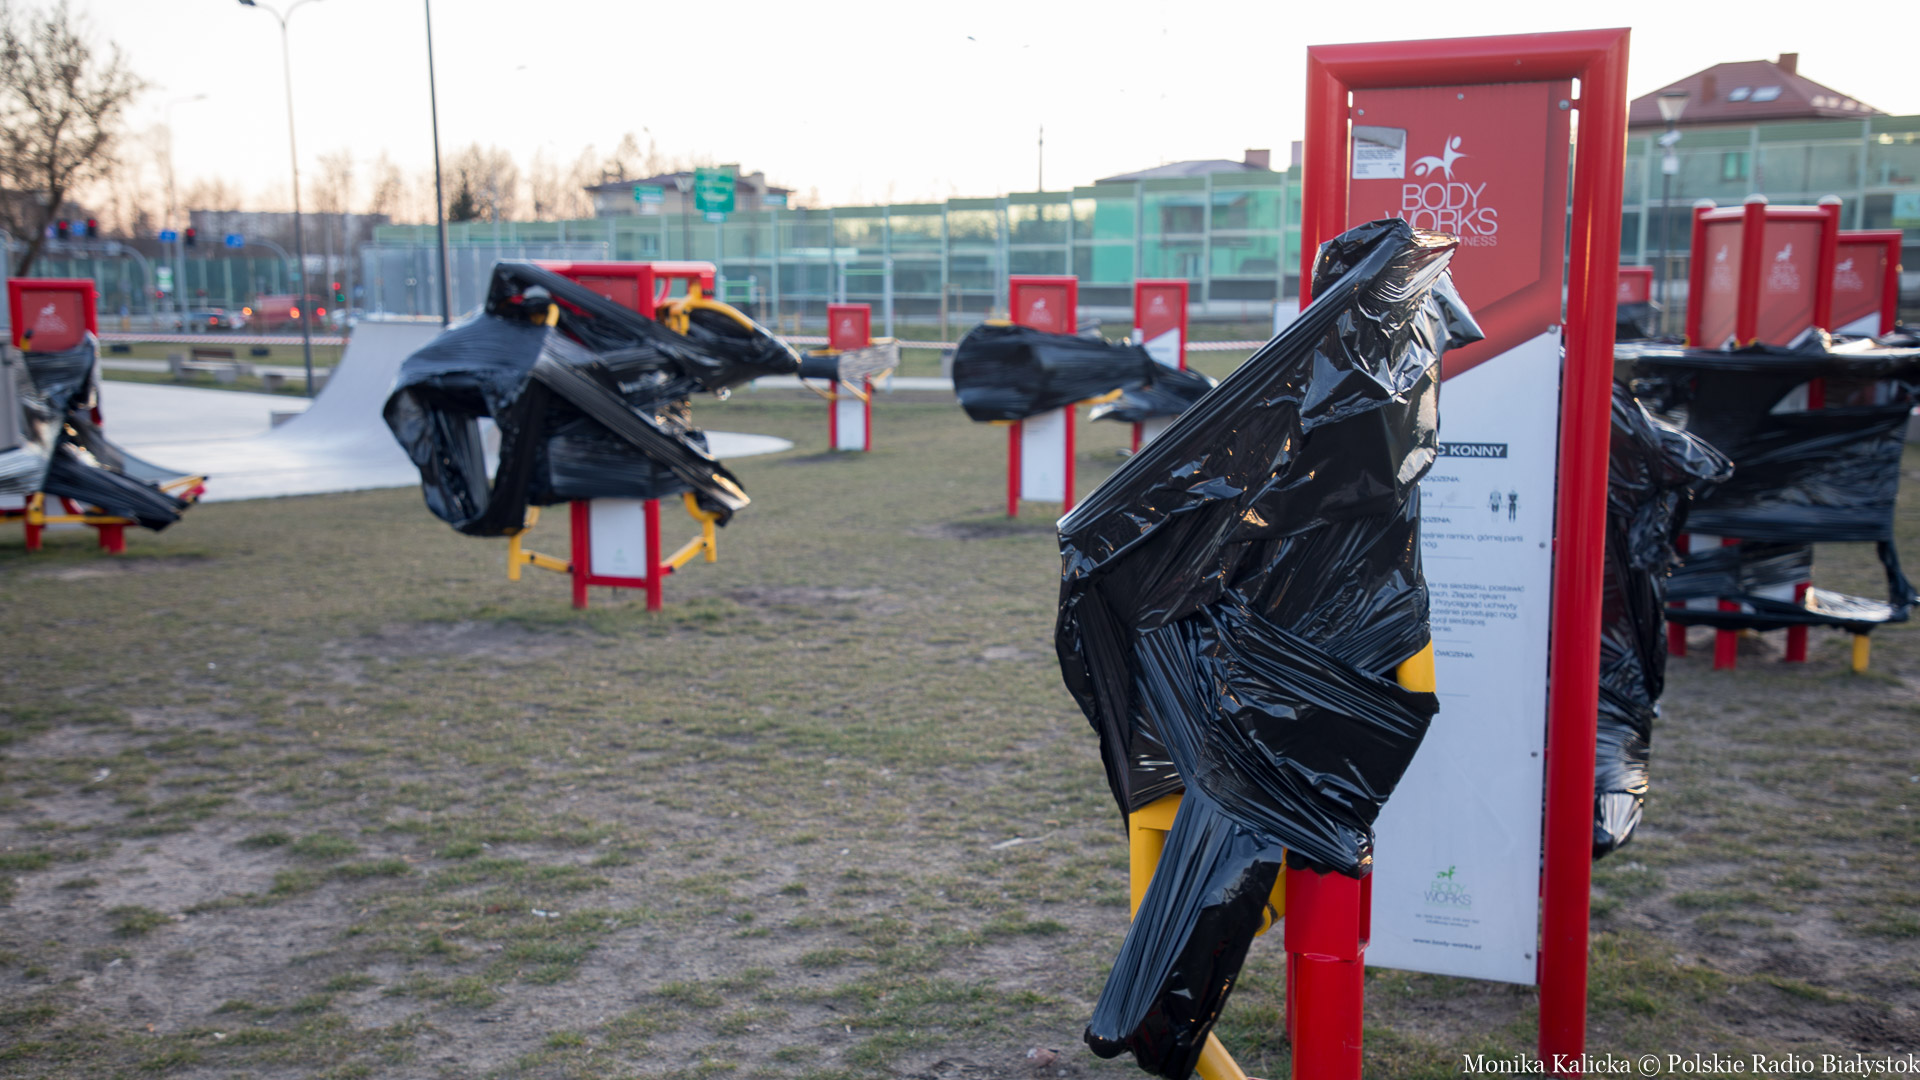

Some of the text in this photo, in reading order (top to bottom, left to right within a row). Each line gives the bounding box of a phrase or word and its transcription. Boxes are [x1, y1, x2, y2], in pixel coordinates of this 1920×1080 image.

[1402, 182, 1487, 210] BODY
[1459, 235, 1497, 246] TNESS
[1450, 444, 1504, 457] KONNY
[1431, 880, 1467, 895] BODY
[1424, 890, 1472, 906] WORKS
